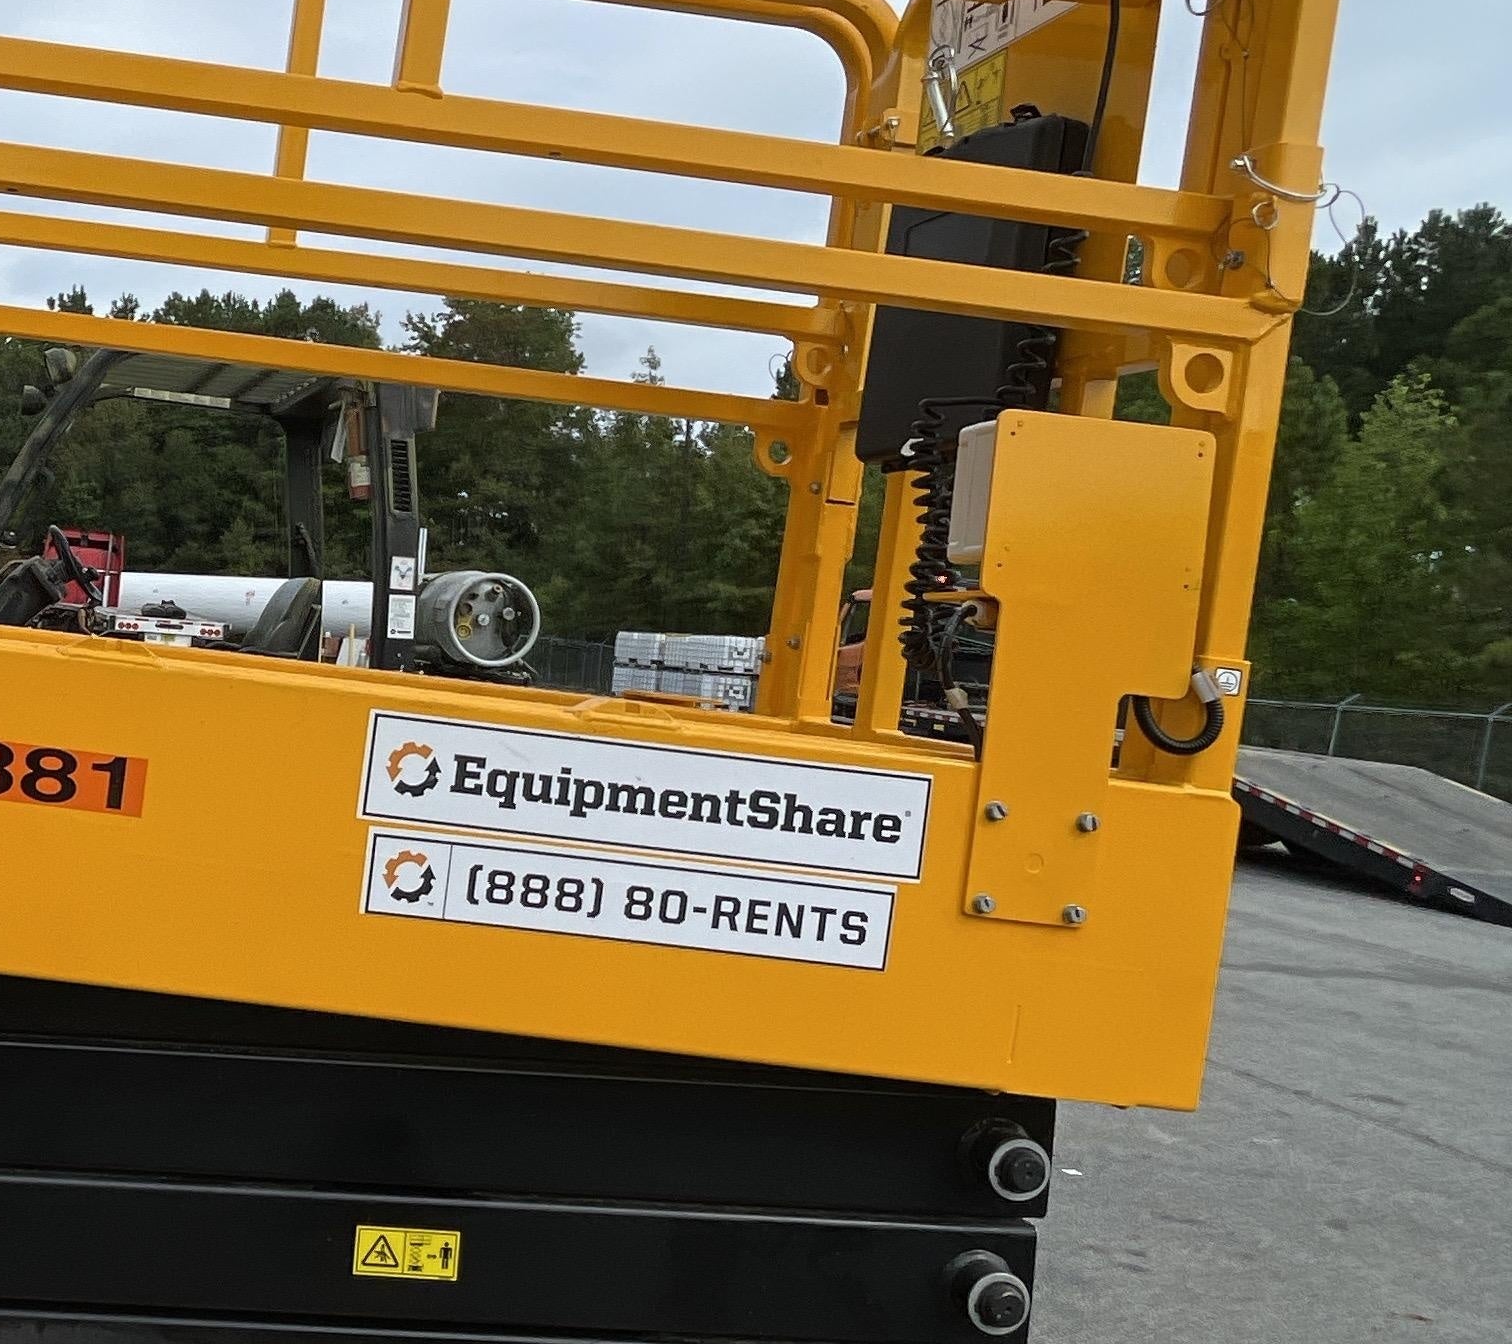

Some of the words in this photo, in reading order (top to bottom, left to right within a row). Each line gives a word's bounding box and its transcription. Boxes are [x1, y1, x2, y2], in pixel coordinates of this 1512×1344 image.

[448, 753, 903, 844] EquipmentShare
[465, 863, 605, 919] (888)
[623, 886, 870, 947] 80-RENTS
